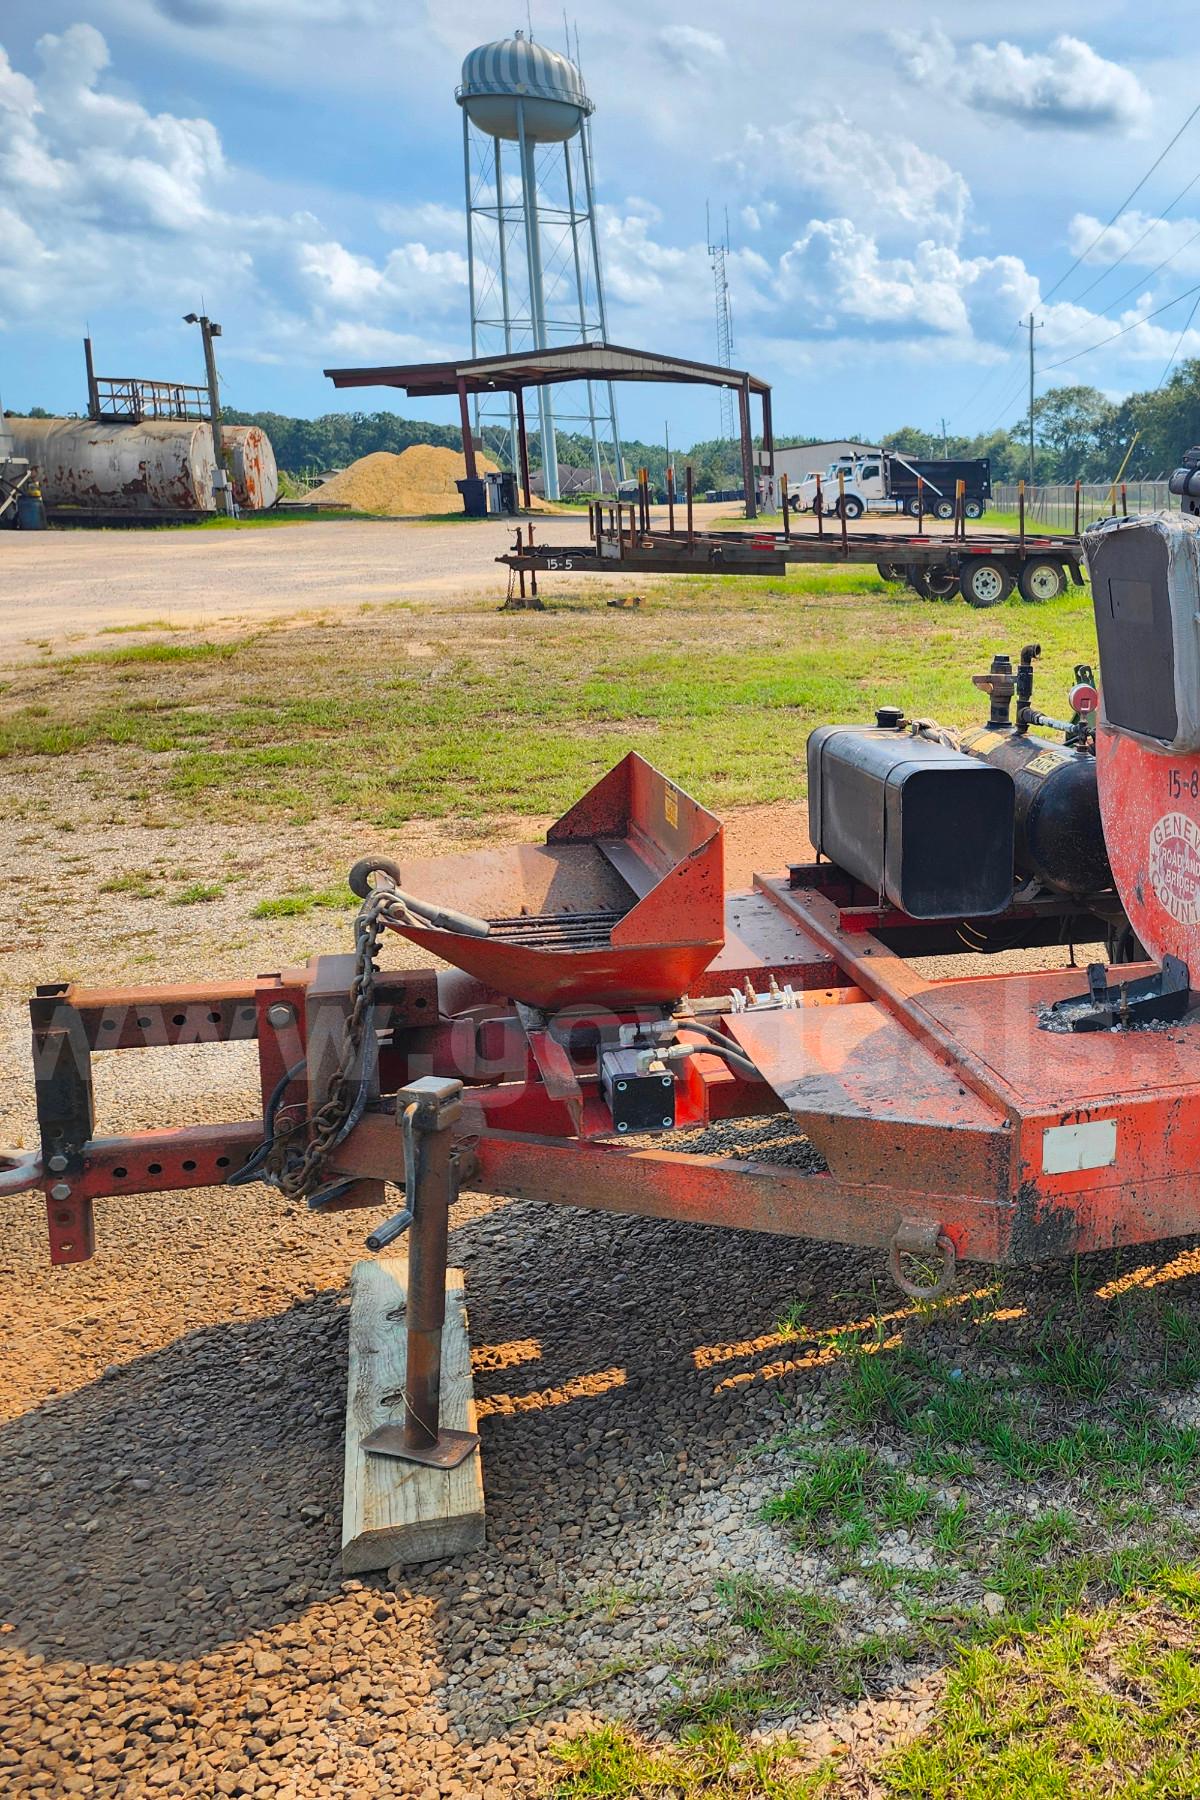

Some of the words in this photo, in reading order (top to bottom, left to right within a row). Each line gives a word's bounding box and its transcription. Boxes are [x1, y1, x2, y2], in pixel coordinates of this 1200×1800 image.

[1168, 769, 1199, 799] 15-8
[1162, 847, 1182, 868] ROAD
[1184, 859, 1200, 876] AND
[1166, 868, 1197, 894] BRIDGE
